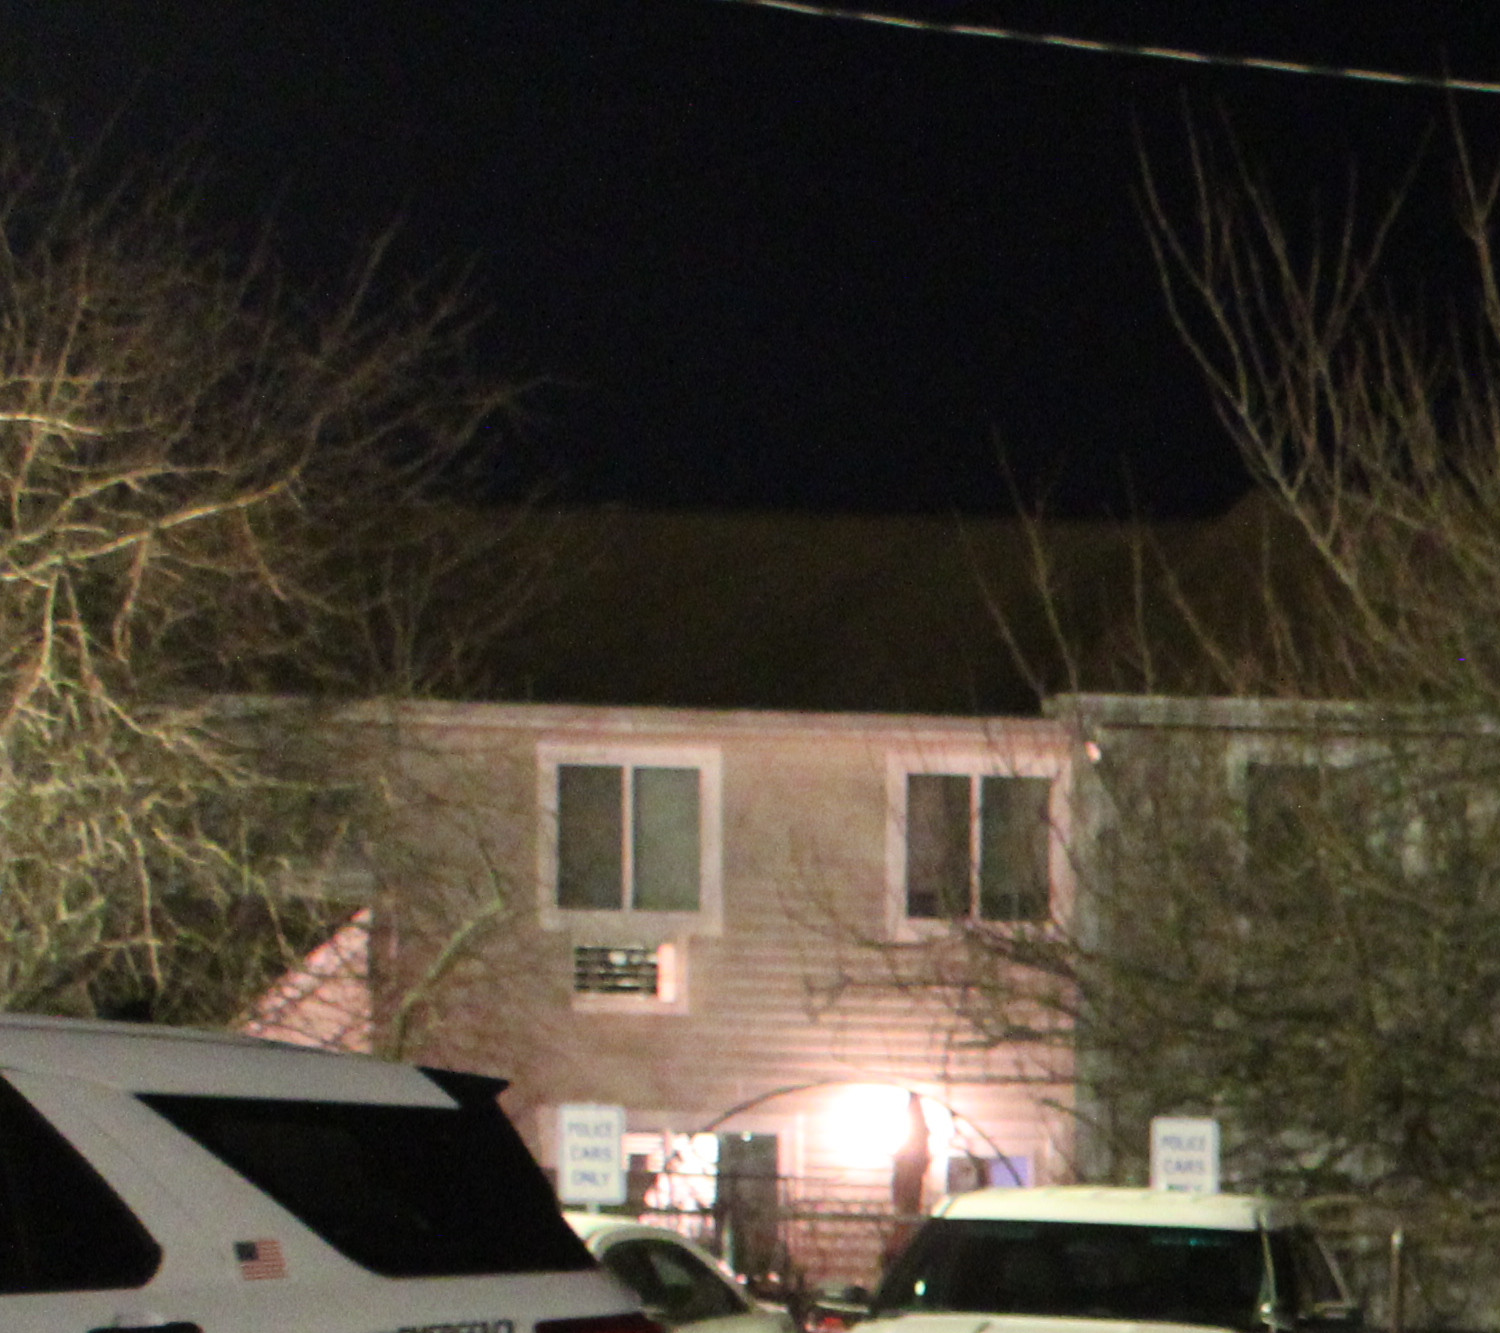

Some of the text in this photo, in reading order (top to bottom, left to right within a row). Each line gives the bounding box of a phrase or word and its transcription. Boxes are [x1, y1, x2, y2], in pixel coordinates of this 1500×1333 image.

[567, 1121, 613, 1137] POLICE
[1162, 1135, 1206, 1151] POLICE
[569, 1145, 612, 1161] CARS
[1164, 1158, 1205, 1174] CARS
